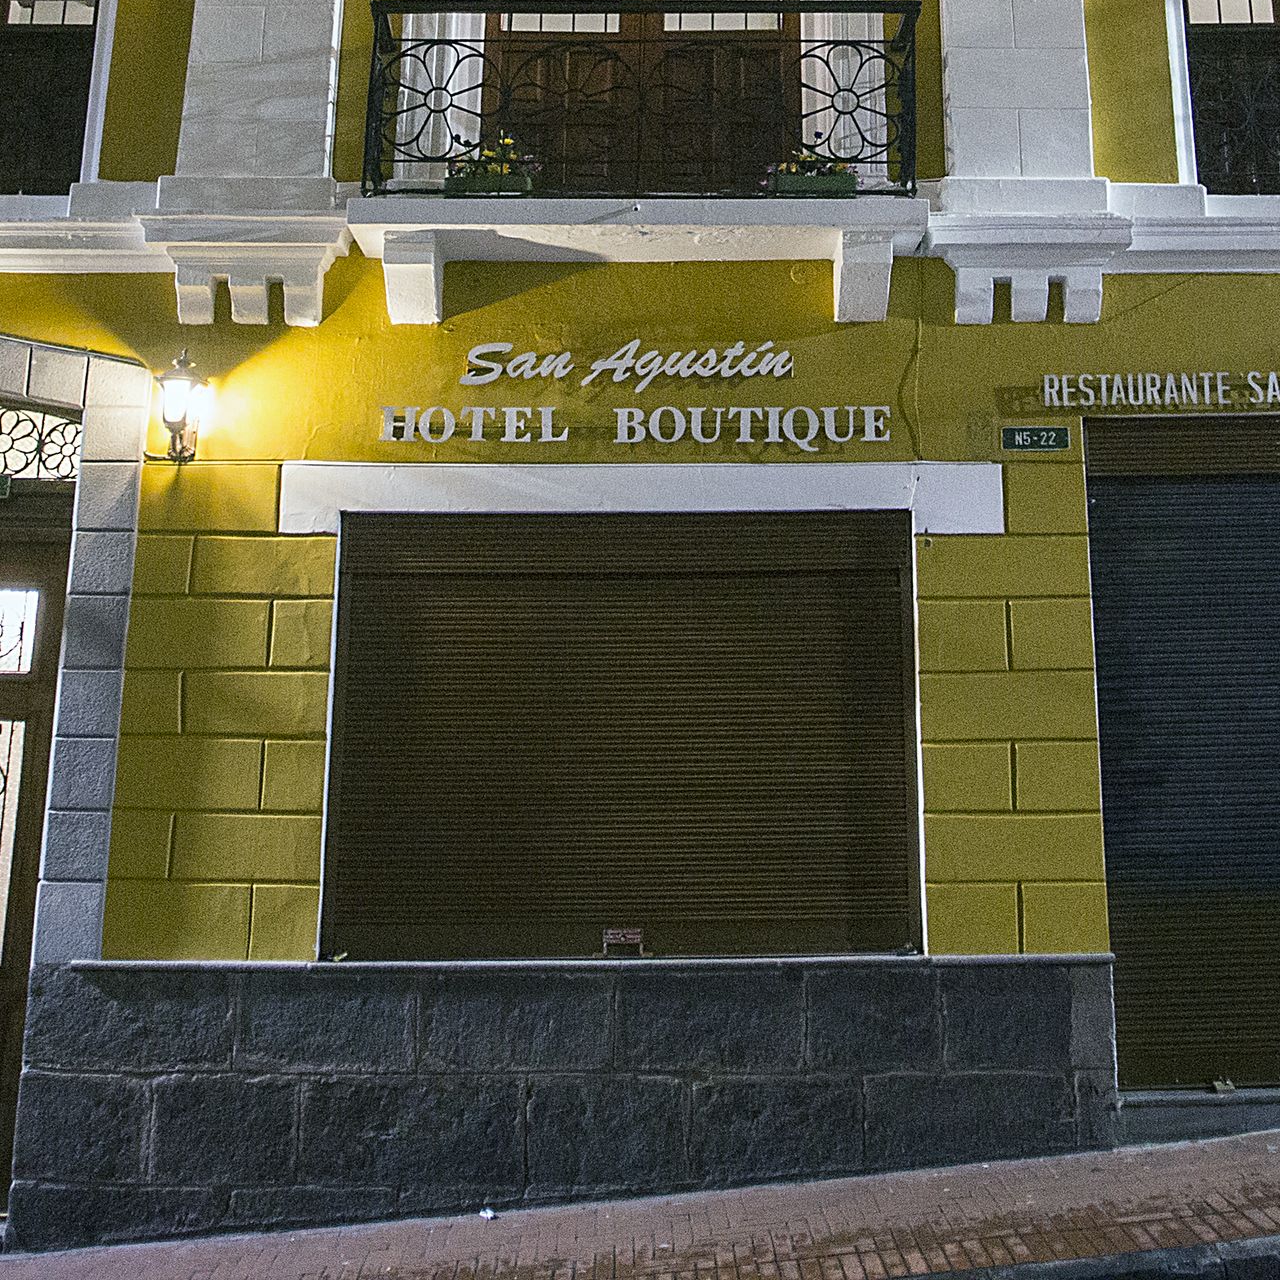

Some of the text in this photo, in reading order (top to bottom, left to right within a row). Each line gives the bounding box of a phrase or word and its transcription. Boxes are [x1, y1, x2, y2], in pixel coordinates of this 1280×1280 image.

[459, 339, 794, 393] San Agustín
[1043, 372, 1231, 407] RESTAURANTE
[379, 405, 891, 452] HOTEL BOUTIQUE
[1014, 431, 1056, 446] N5-22
